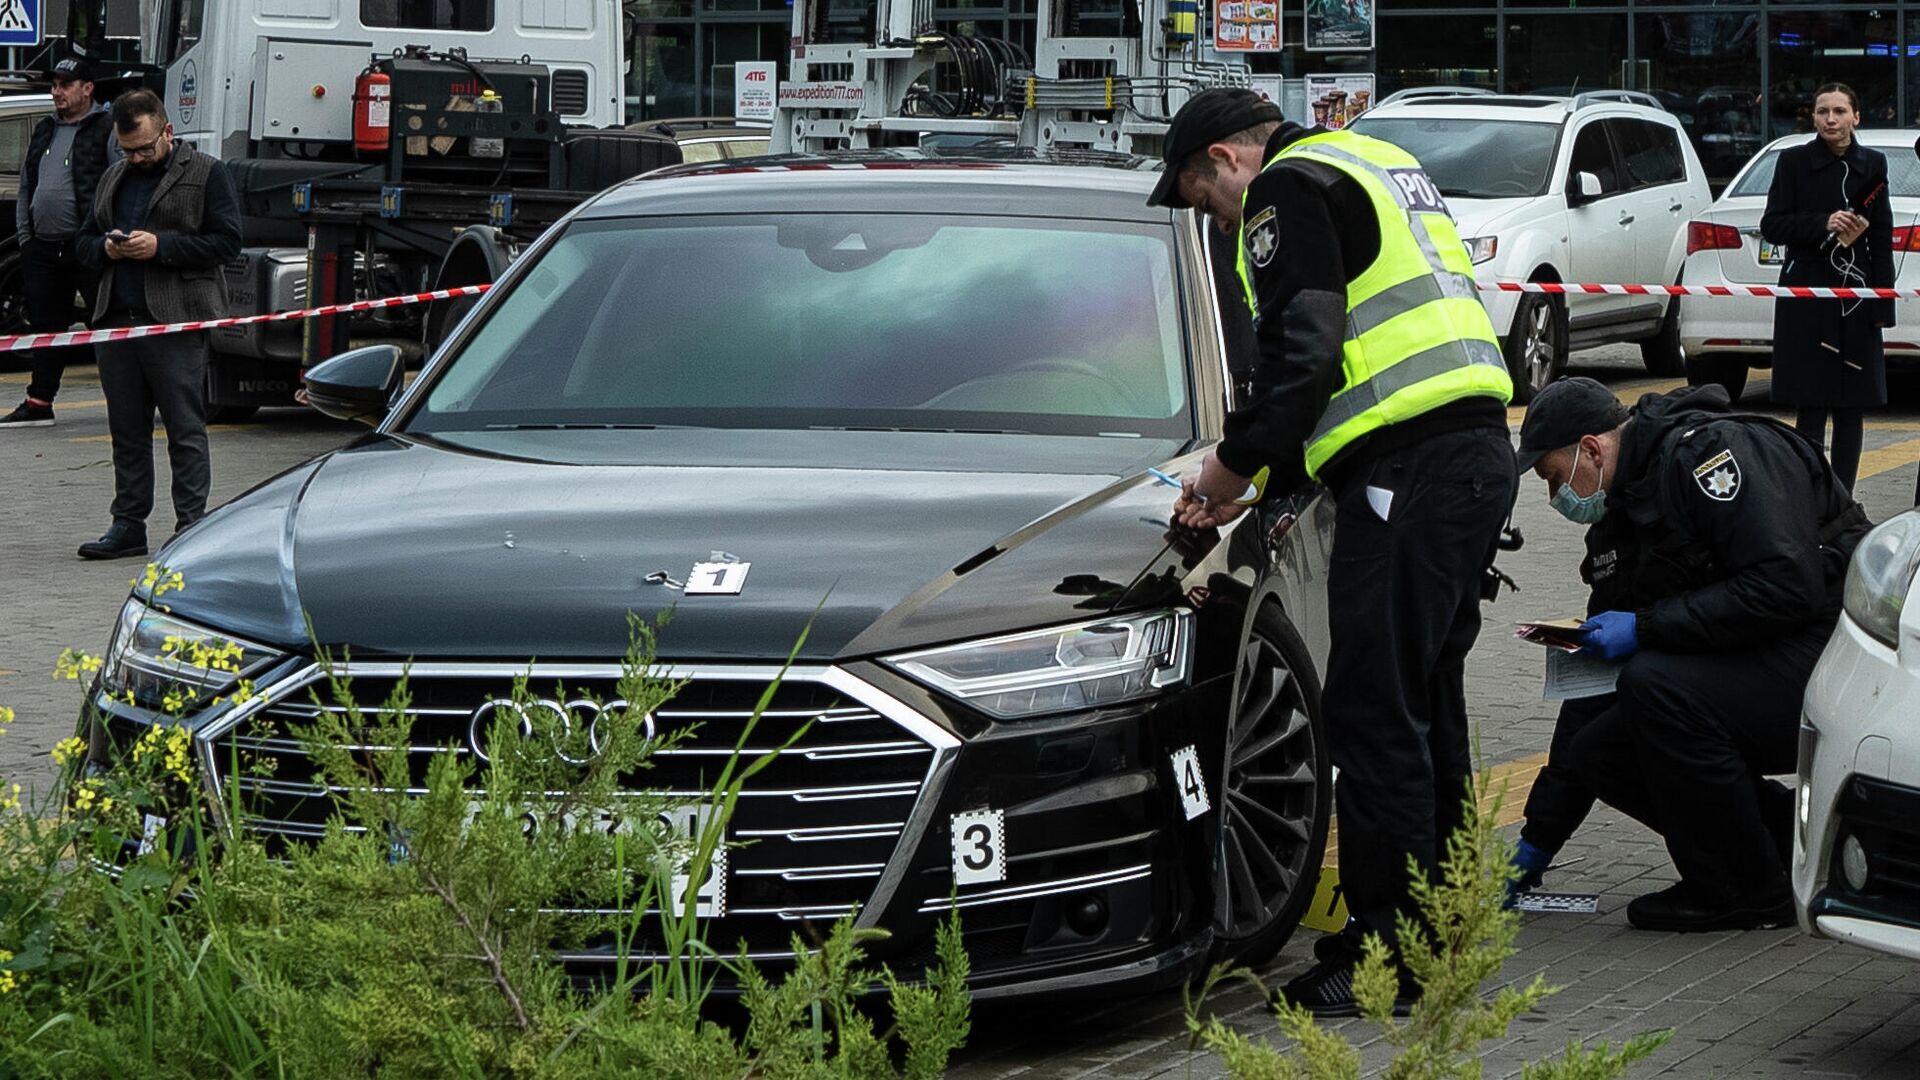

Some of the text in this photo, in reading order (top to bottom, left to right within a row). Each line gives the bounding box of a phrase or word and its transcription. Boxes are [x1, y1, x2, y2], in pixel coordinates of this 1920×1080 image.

[779, 85, 863, 102] www.expedition777.com
[239, 380, 288, 392] IVECO
[706, 568, 728, 586] 1
[1184, 758, 1201, 803] 4
[962, 824, 994, 871] 3
